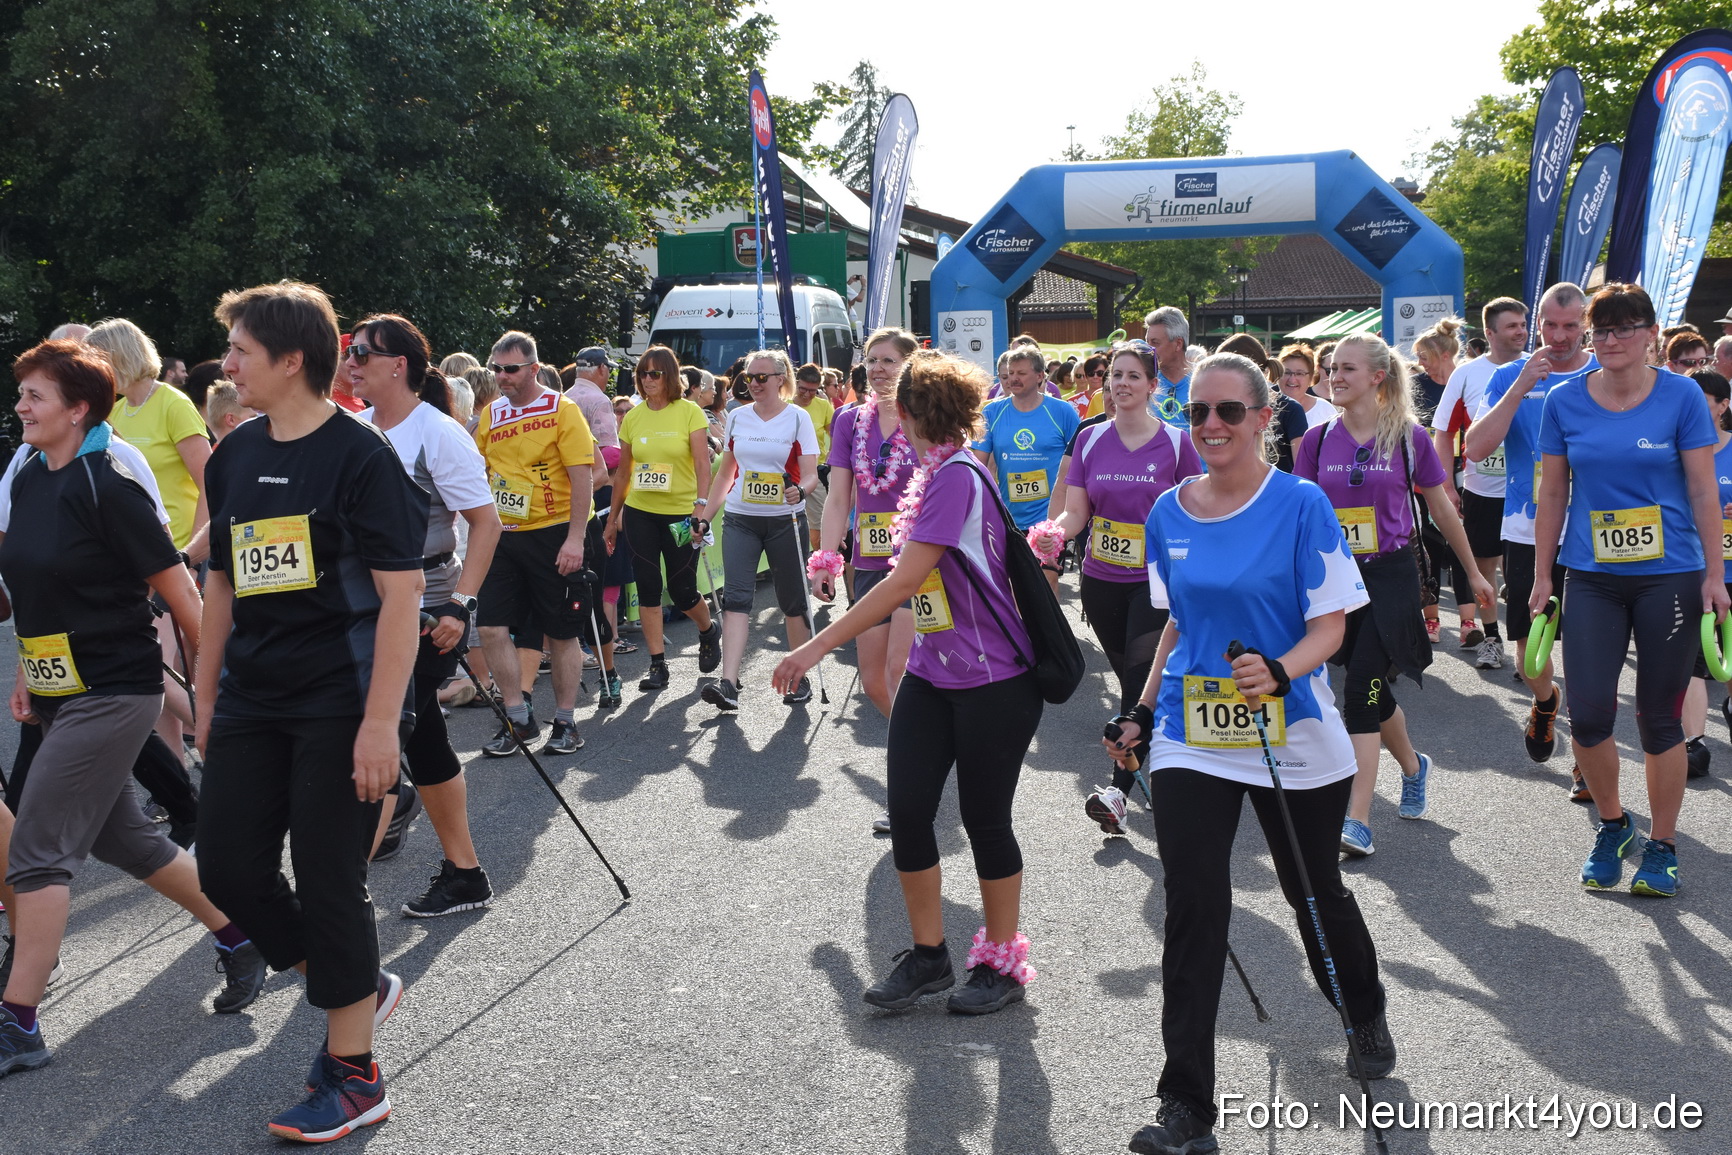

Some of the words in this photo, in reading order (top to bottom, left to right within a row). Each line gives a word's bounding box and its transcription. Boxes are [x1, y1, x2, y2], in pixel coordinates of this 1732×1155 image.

[1544, 92, 1571, 185] Fischer
[1554, 104, 1574, 180] AUTOMOBILE
[1184, 182, 1215, 190] Fischer
[1584, 165, 1609, 225] Fischer
[1160, 196, 1254, 216] firmenlauf
[1592, 175, 1612, 223] AUTOMOBILE
[1352, 224, 1366, 232] und
[985, 237, 1034, 247] Fischer
[878, 251, 893, 330] er-automobile.de
[664, 308, 704, 318] abavent
[490, 426, 519, 444] MAX
[522, 418, 558, 433] BÖGL
[1370, 464, 1394, 472] LILA.
[1483, 457, 1505, 468] 371
[637, 472, 666, 484] 1296
[1136, 476, 1158, 484] LILA.
[747, 482, 778, 496] 1095
[1015, 482, 1039, 494] 976
[495, 490, 524, 508] 1654
[1340, 524, 1360, 540] 01
[1600, 526, 1654, 548] 1085
[1101, 534, 1131, 555] 882
[240, 543, 300, 575] 1954
[262, 572, 287, 580] Kerstin
[914, 594, 932, 616] 86
[22, 657, 66, 680] 1965
[1196, 690, 1234, 698] firmenlauf
[1196, 702, 1271, 728] 1084
